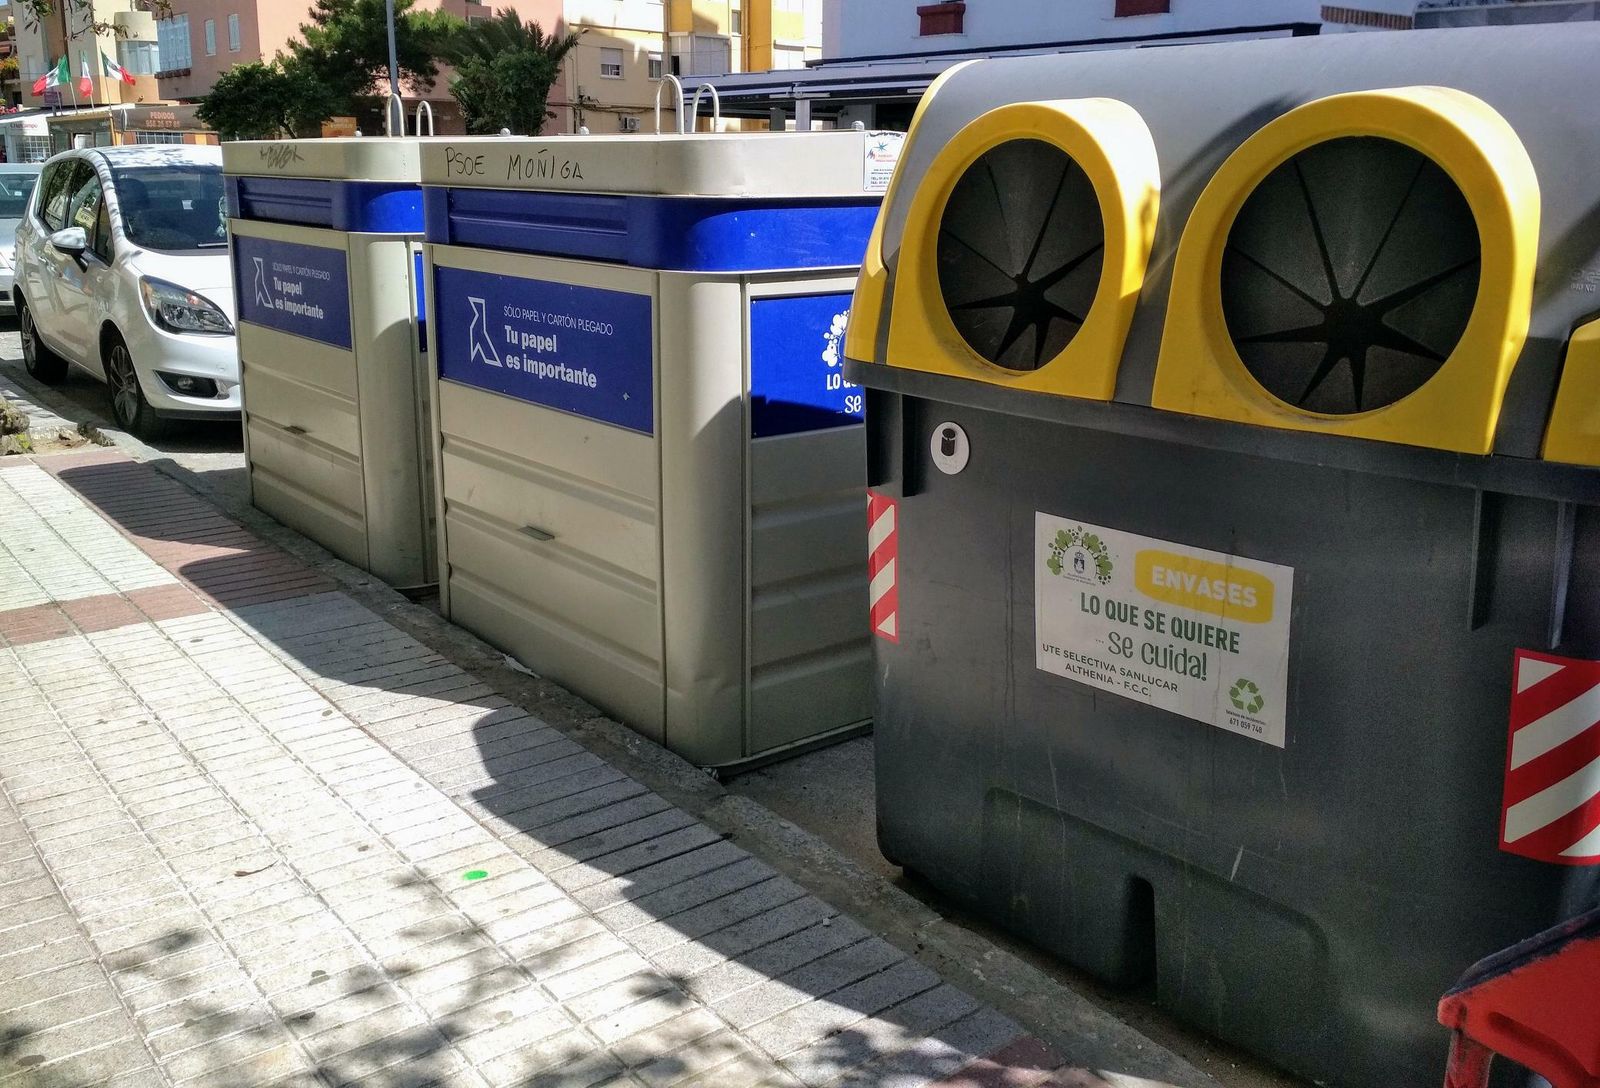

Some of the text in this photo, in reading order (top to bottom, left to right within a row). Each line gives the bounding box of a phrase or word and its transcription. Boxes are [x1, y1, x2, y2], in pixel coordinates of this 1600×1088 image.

[445, 146, 485, 177] PSOE
[273, 276, 302, 296] Tu papel
[275, 297, 324, 319] es importante
[503, 304, 614, 336] SÓLO PAPEL Y CARTÓN PLEGADO
[504, 325, 557, 353] Tu papel
[506, 354, 598, 388] es importante
[826, 373, 841, 390] LO
[1152, 566, 1258, 608] ENVASES
[1081, 592, 1240, 654] LO QUE SE QUIERE
[1042, 643, 1178, 692] UTE SELECTIVA SANLUCAR
[1065, 663, 1114, 685] ALTHENIA
[1141, 642, 1207, 681] cuida!
[1230, 717, 1263, 734] 671 059 748
